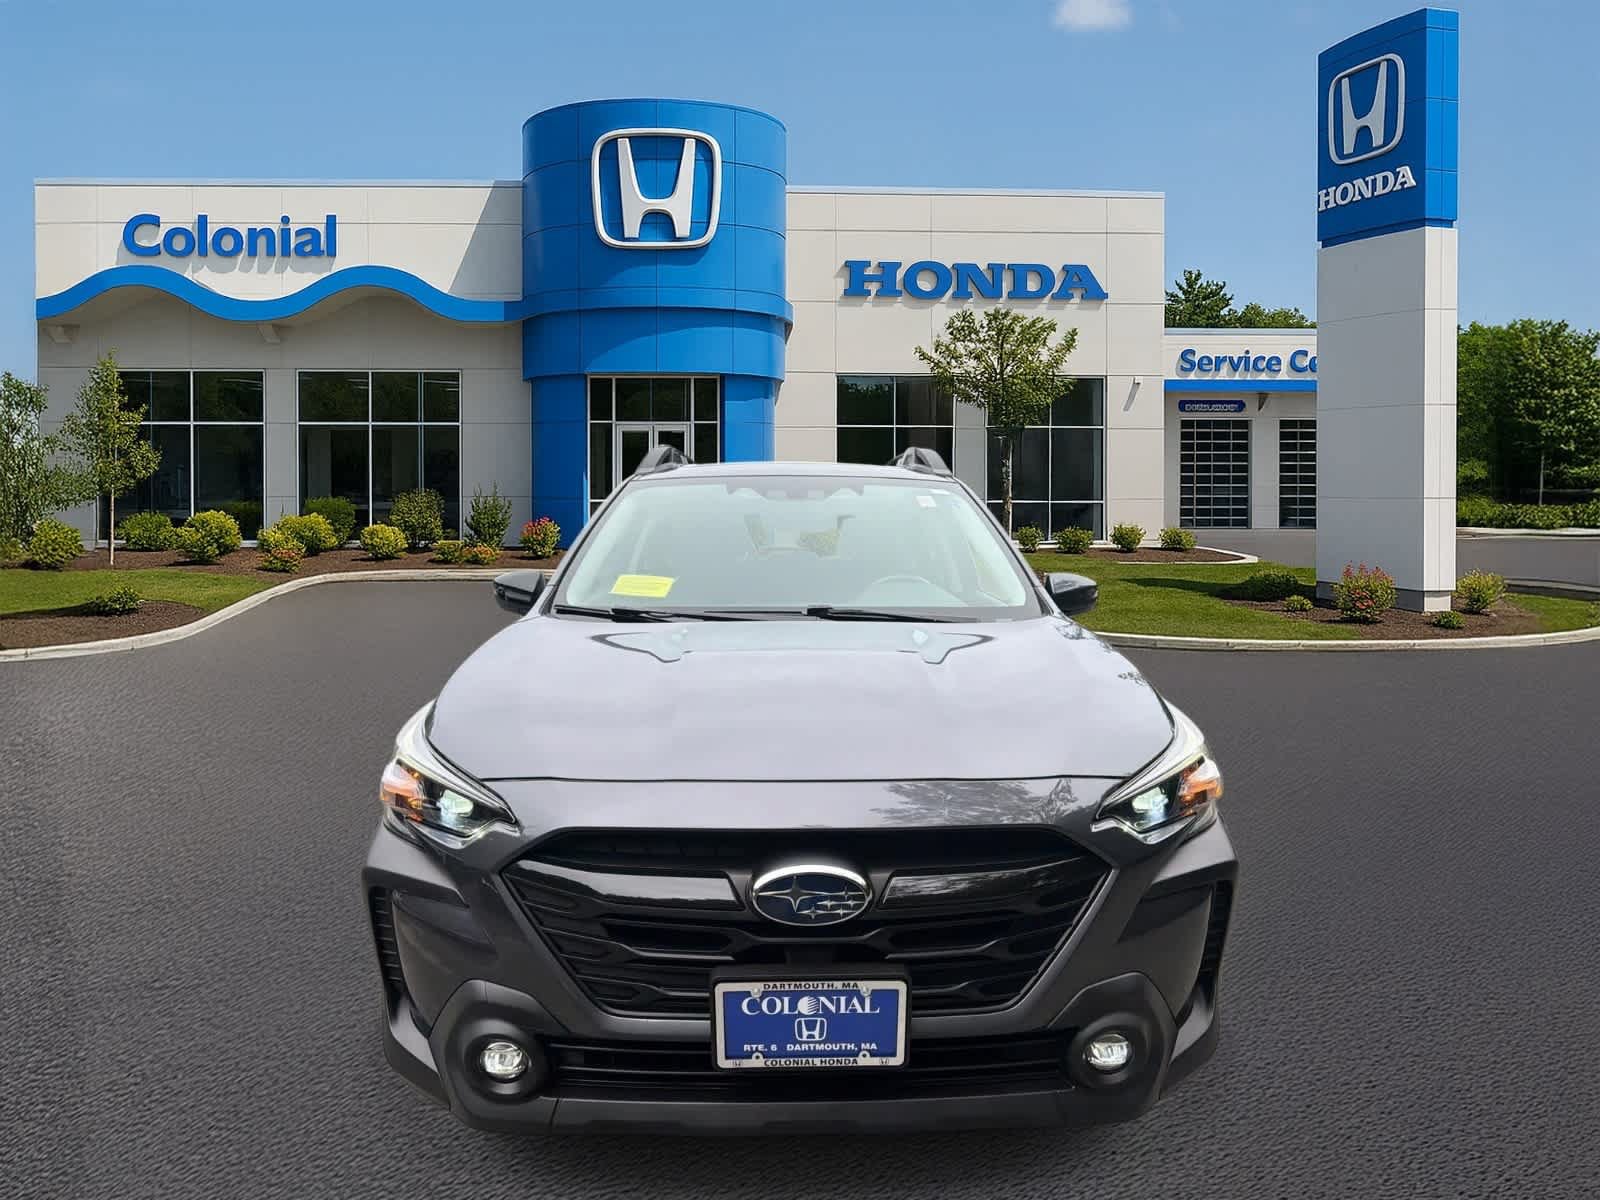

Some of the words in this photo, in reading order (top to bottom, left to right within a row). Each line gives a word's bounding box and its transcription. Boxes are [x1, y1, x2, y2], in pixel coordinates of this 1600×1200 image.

[1318, 165, 1416, 212] HONDA
[122, 213, 337, 258] Colonial
[843, 259, 1109, 300] HONDA
[1180, 348, 1283, 373] Service
[741, 995, 880, 1015] COLONIAL
[743, 1044, 768, 1052] RTE.
[770, 1044, 778, 1052] 6
[786, 1043, 858, 1052] DARTMOUTH,
[861, 1042, 878, 1051] MA
[764, 1059, 817, 1067] COLONIAL
[820, 1058, 859, 1066] HONDA
